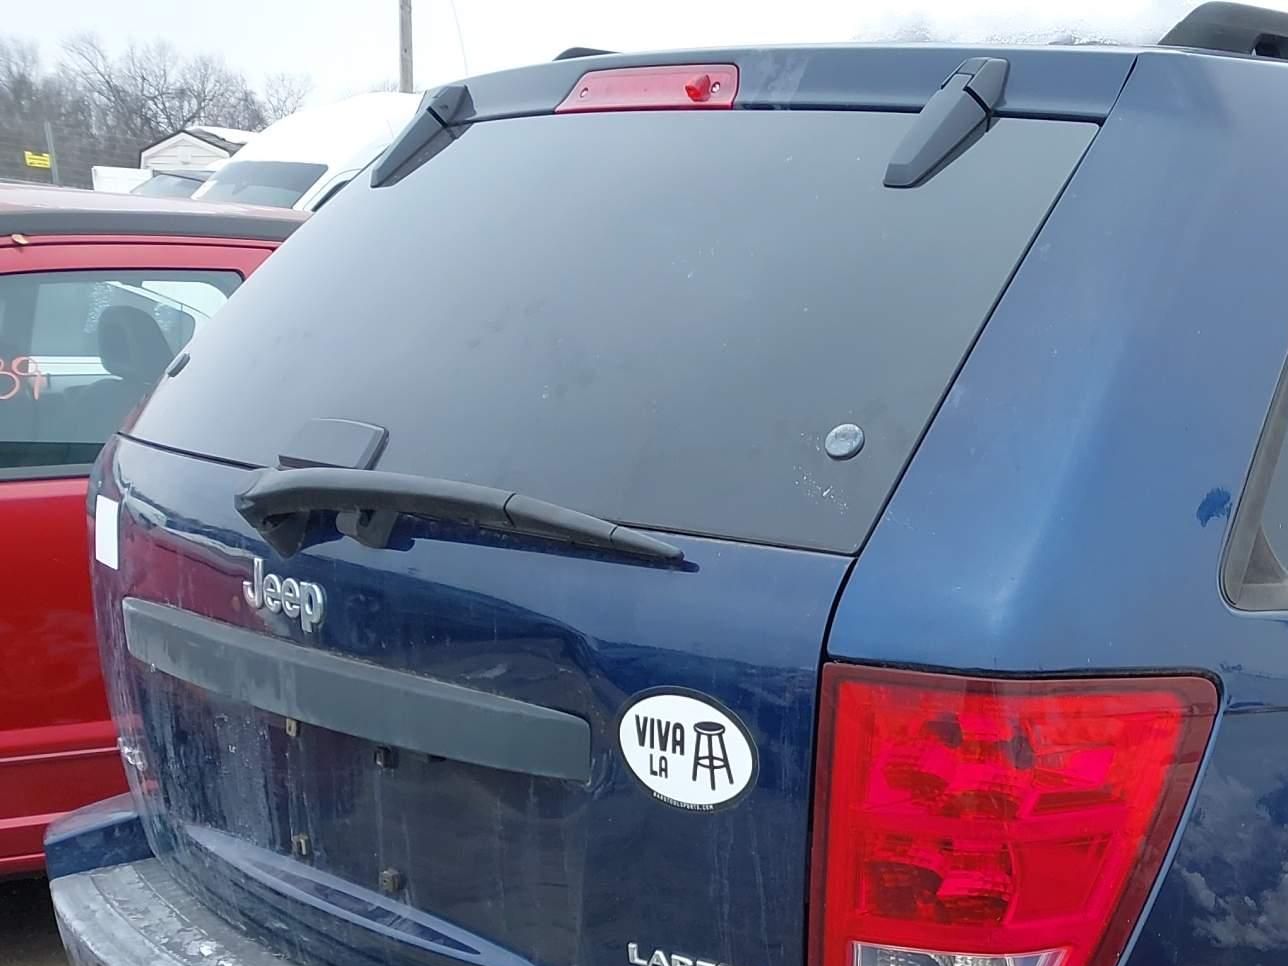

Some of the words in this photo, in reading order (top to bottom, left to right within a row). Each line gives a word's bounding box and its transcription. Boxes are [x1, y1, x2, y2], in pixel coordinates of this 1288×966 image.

[242, 557, 327, 633] Jeep
[634, 713, 685, 756] VIVA
[649, 753, 669, 779] LA
